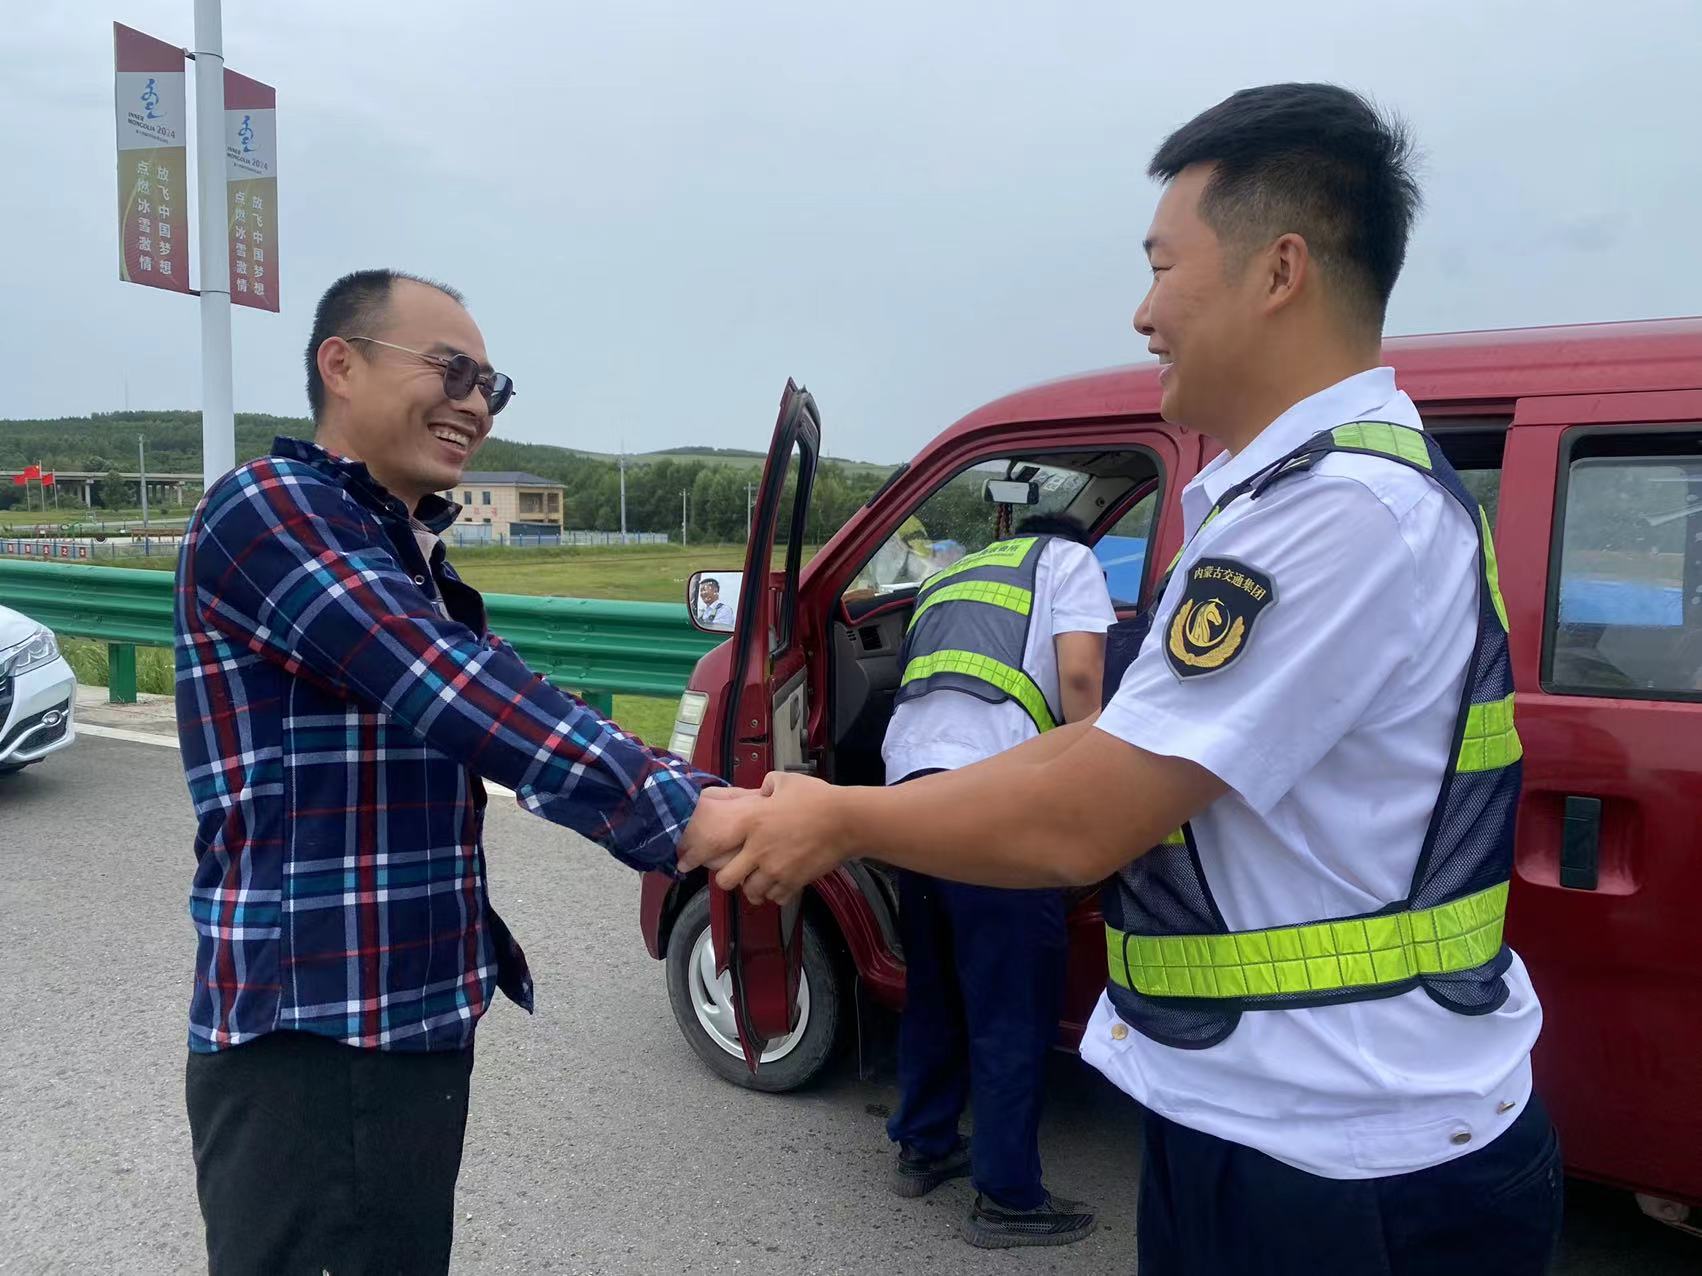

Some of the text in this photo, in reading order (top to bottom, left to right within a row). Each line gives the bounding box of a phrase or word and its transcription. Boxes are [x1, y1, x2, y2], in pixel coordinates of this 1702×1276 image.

[128, 112, 144, 121] INNER
[128, 118, 155, 131] MONGOLIA
[157, 125, 175, 138] 2024
[136, 160, 152, 271] 点燃冰雪激情
[157, 165, 172, 275] 放飞中国梦想
[235, 191, 248, 292] 点燃冰雪激情
[252, 196, 265, 296] 放飞中国梦想
[1194, 566, 1266, 600] 内蒙古交通集团
